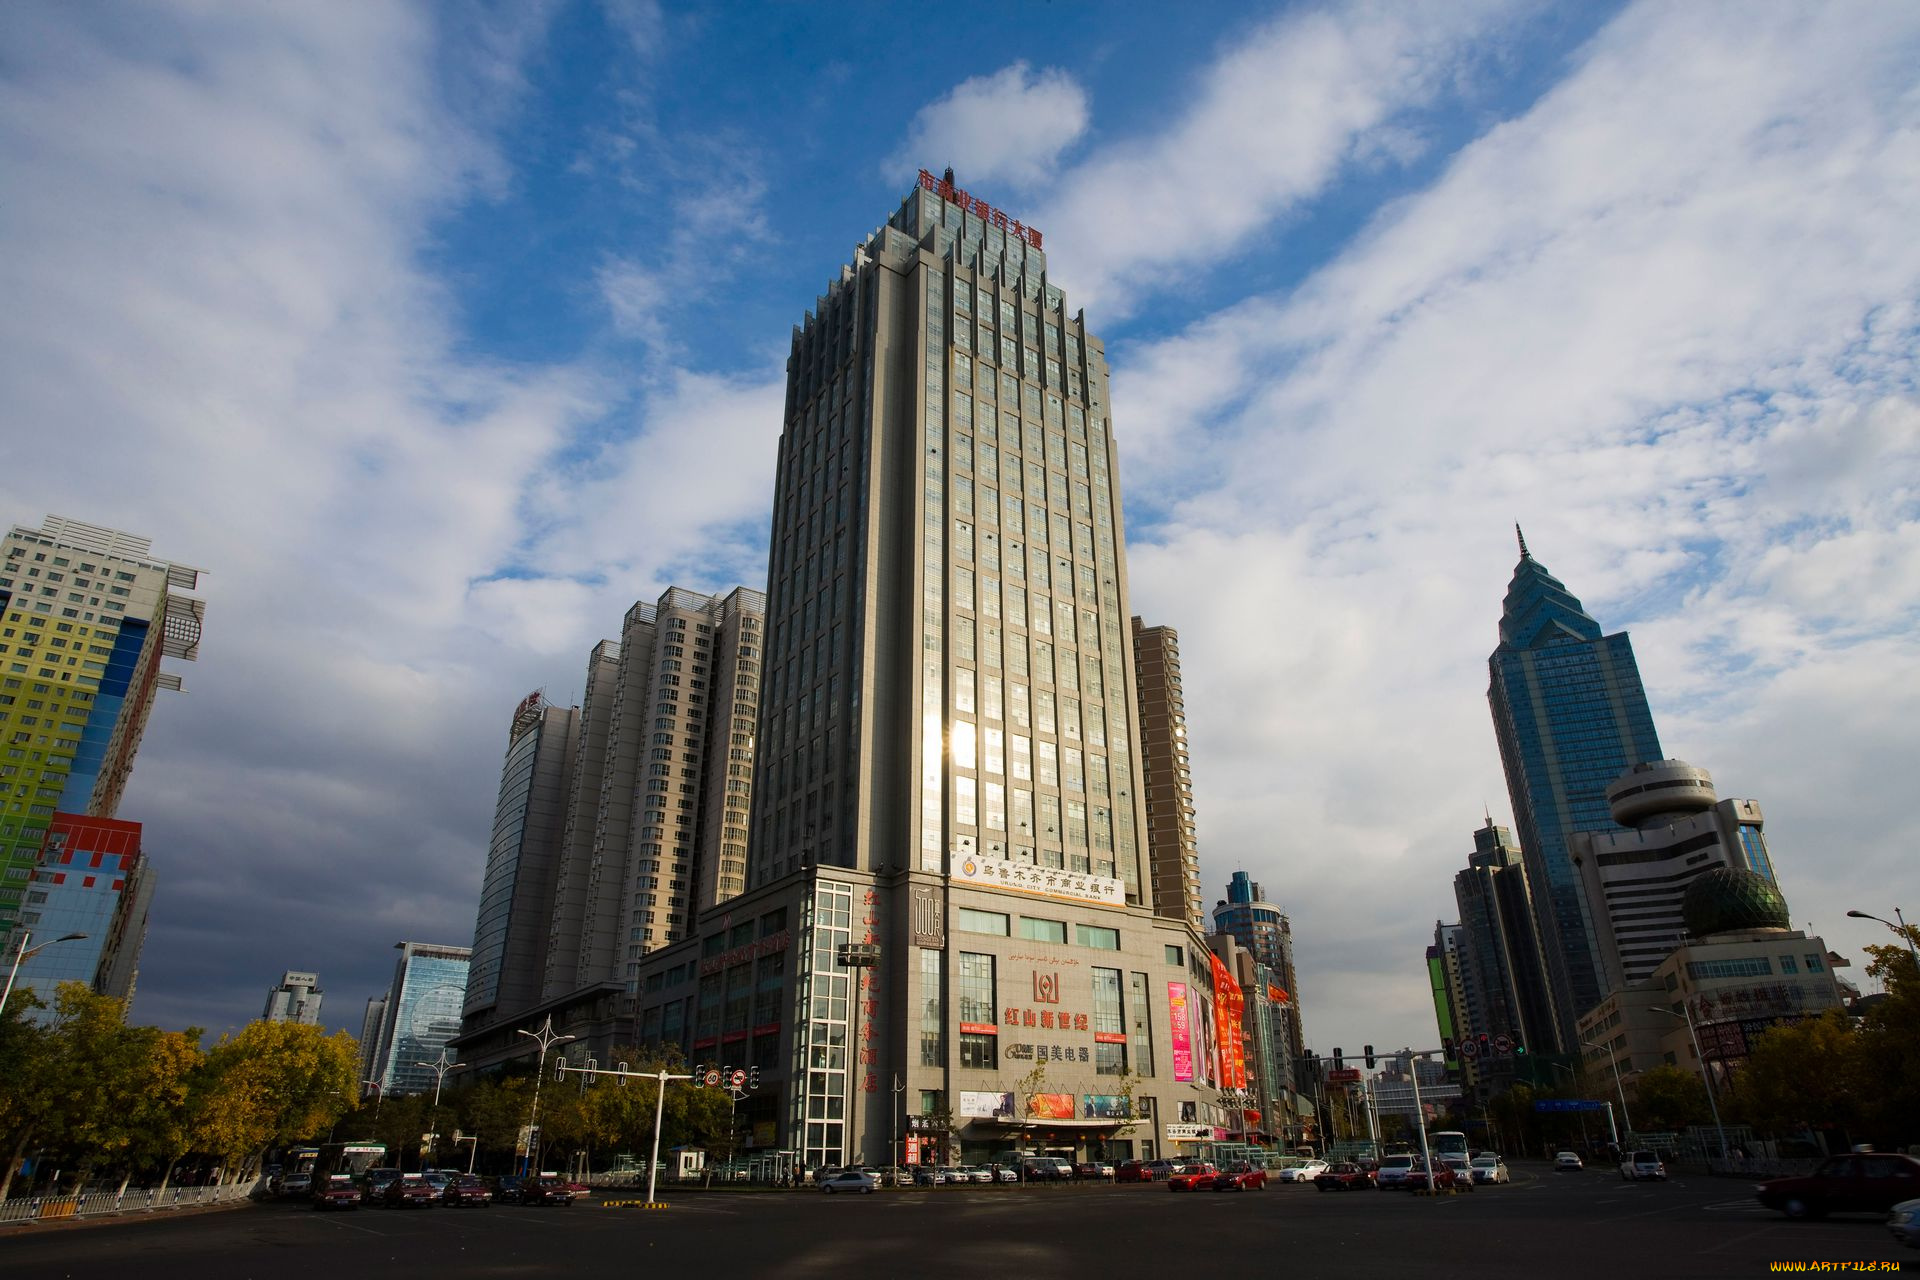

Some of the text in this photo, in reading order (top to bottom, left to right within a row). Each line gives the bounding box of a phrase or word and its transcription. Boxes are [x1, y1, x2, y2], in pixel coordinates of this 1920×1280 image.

[918, 168, 1043, 249] 市商业银行大厦
[983, 865, 1115, 895] 乌鲁木齐市商业银行
[858, 887, 881, 1094] 红山新纪商务酒店
[1004, 1007, 1088, 1031] 红山新世纪
[1036, 1044, 1089, 1062] 国美电器
[1464, 1044, 1474, 1052] 60
